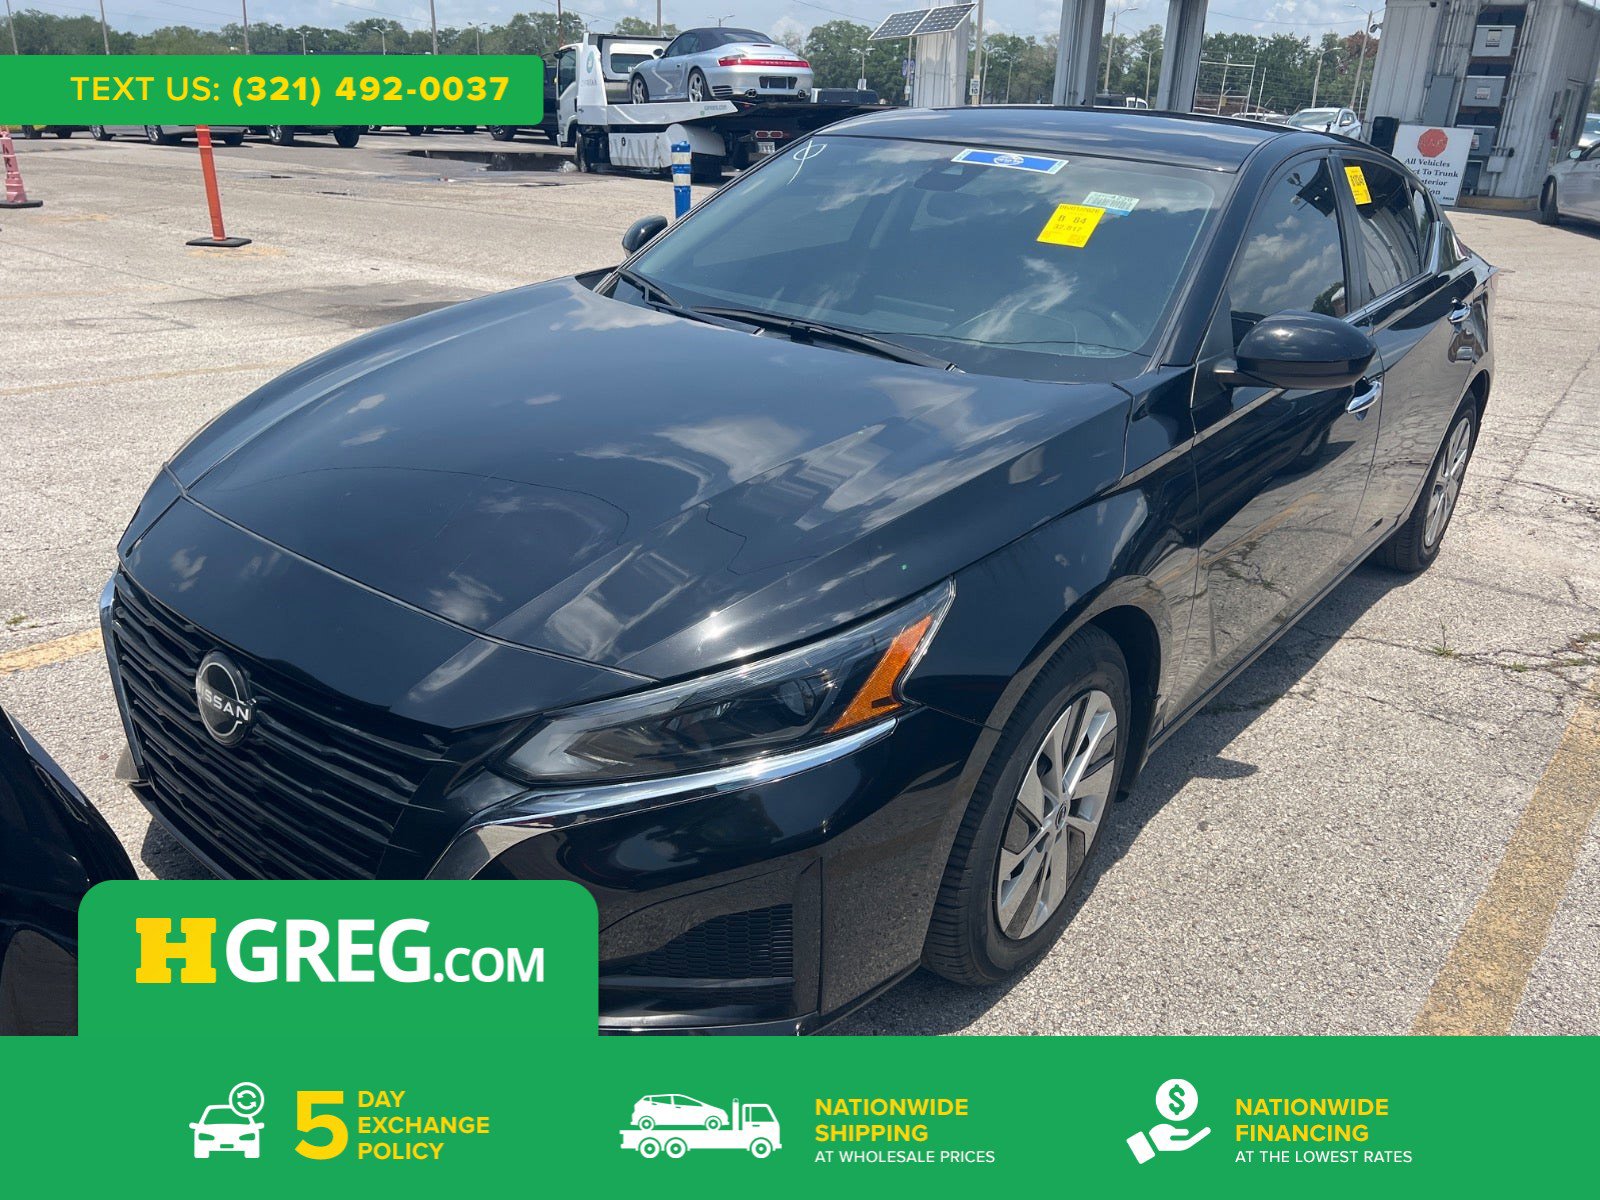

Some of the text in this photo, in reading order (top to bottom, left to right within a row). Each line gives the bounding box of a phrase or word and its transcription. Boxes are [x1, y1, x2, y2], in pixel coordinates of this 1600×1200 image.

[1419, 158, 1450, 168] Vehicles
[1422, 168, 1432, 176] To
[1434, 169, 1459, 178] Trunk
